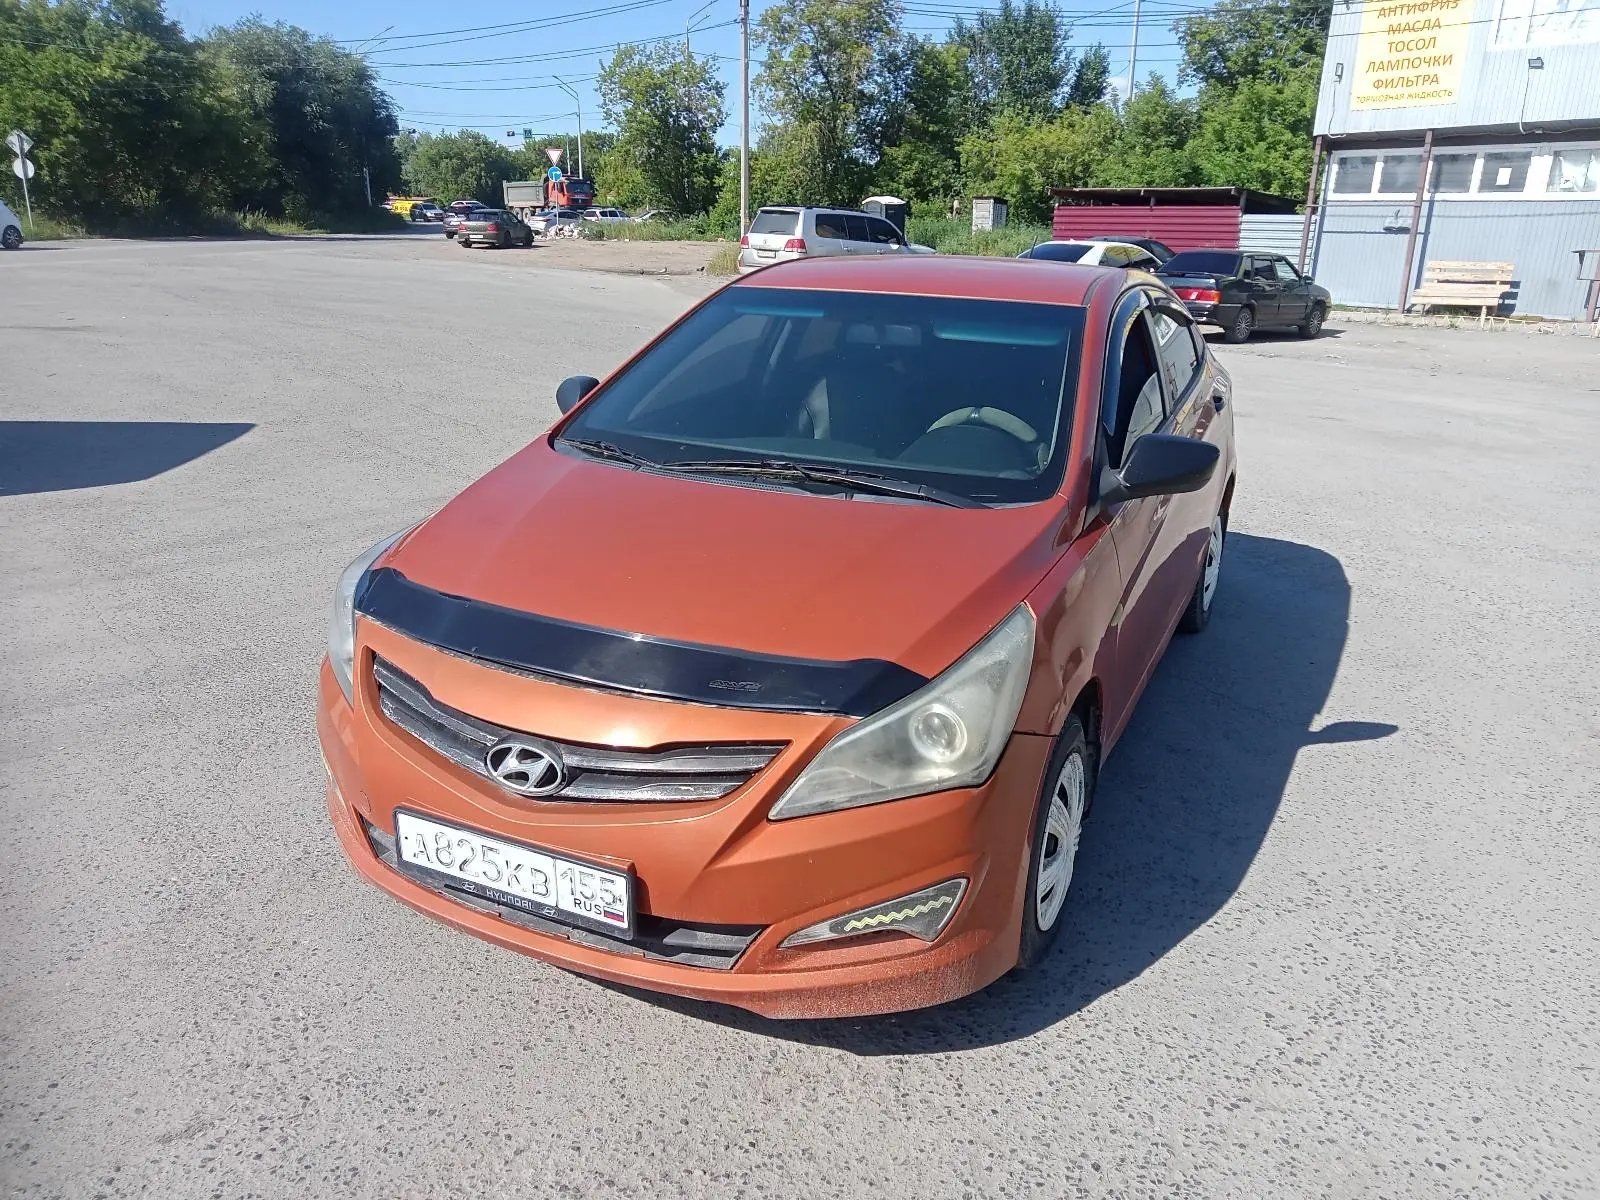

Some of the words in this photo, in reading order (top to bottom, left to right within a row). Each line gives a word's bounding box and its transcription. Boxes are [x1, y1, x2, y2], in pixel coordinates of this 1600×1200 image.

[1377, 0, 1459, 19] АНТИФРИЗ
[1387, 17, 1442, 36] МАСЛА
[1388, 37, 1437, 54] ТОСОЛ
[1365, 54, 1453, 74] ЛАМПОЧКИ
[1372, 74, 1440, 90] ФИЛЬТРА
[1406, 89, 1453, 100] ЖИДКОСТЬ
[486, 889, 535, 910] HYUNDAI
[574, 899, 602, 916] RUS
